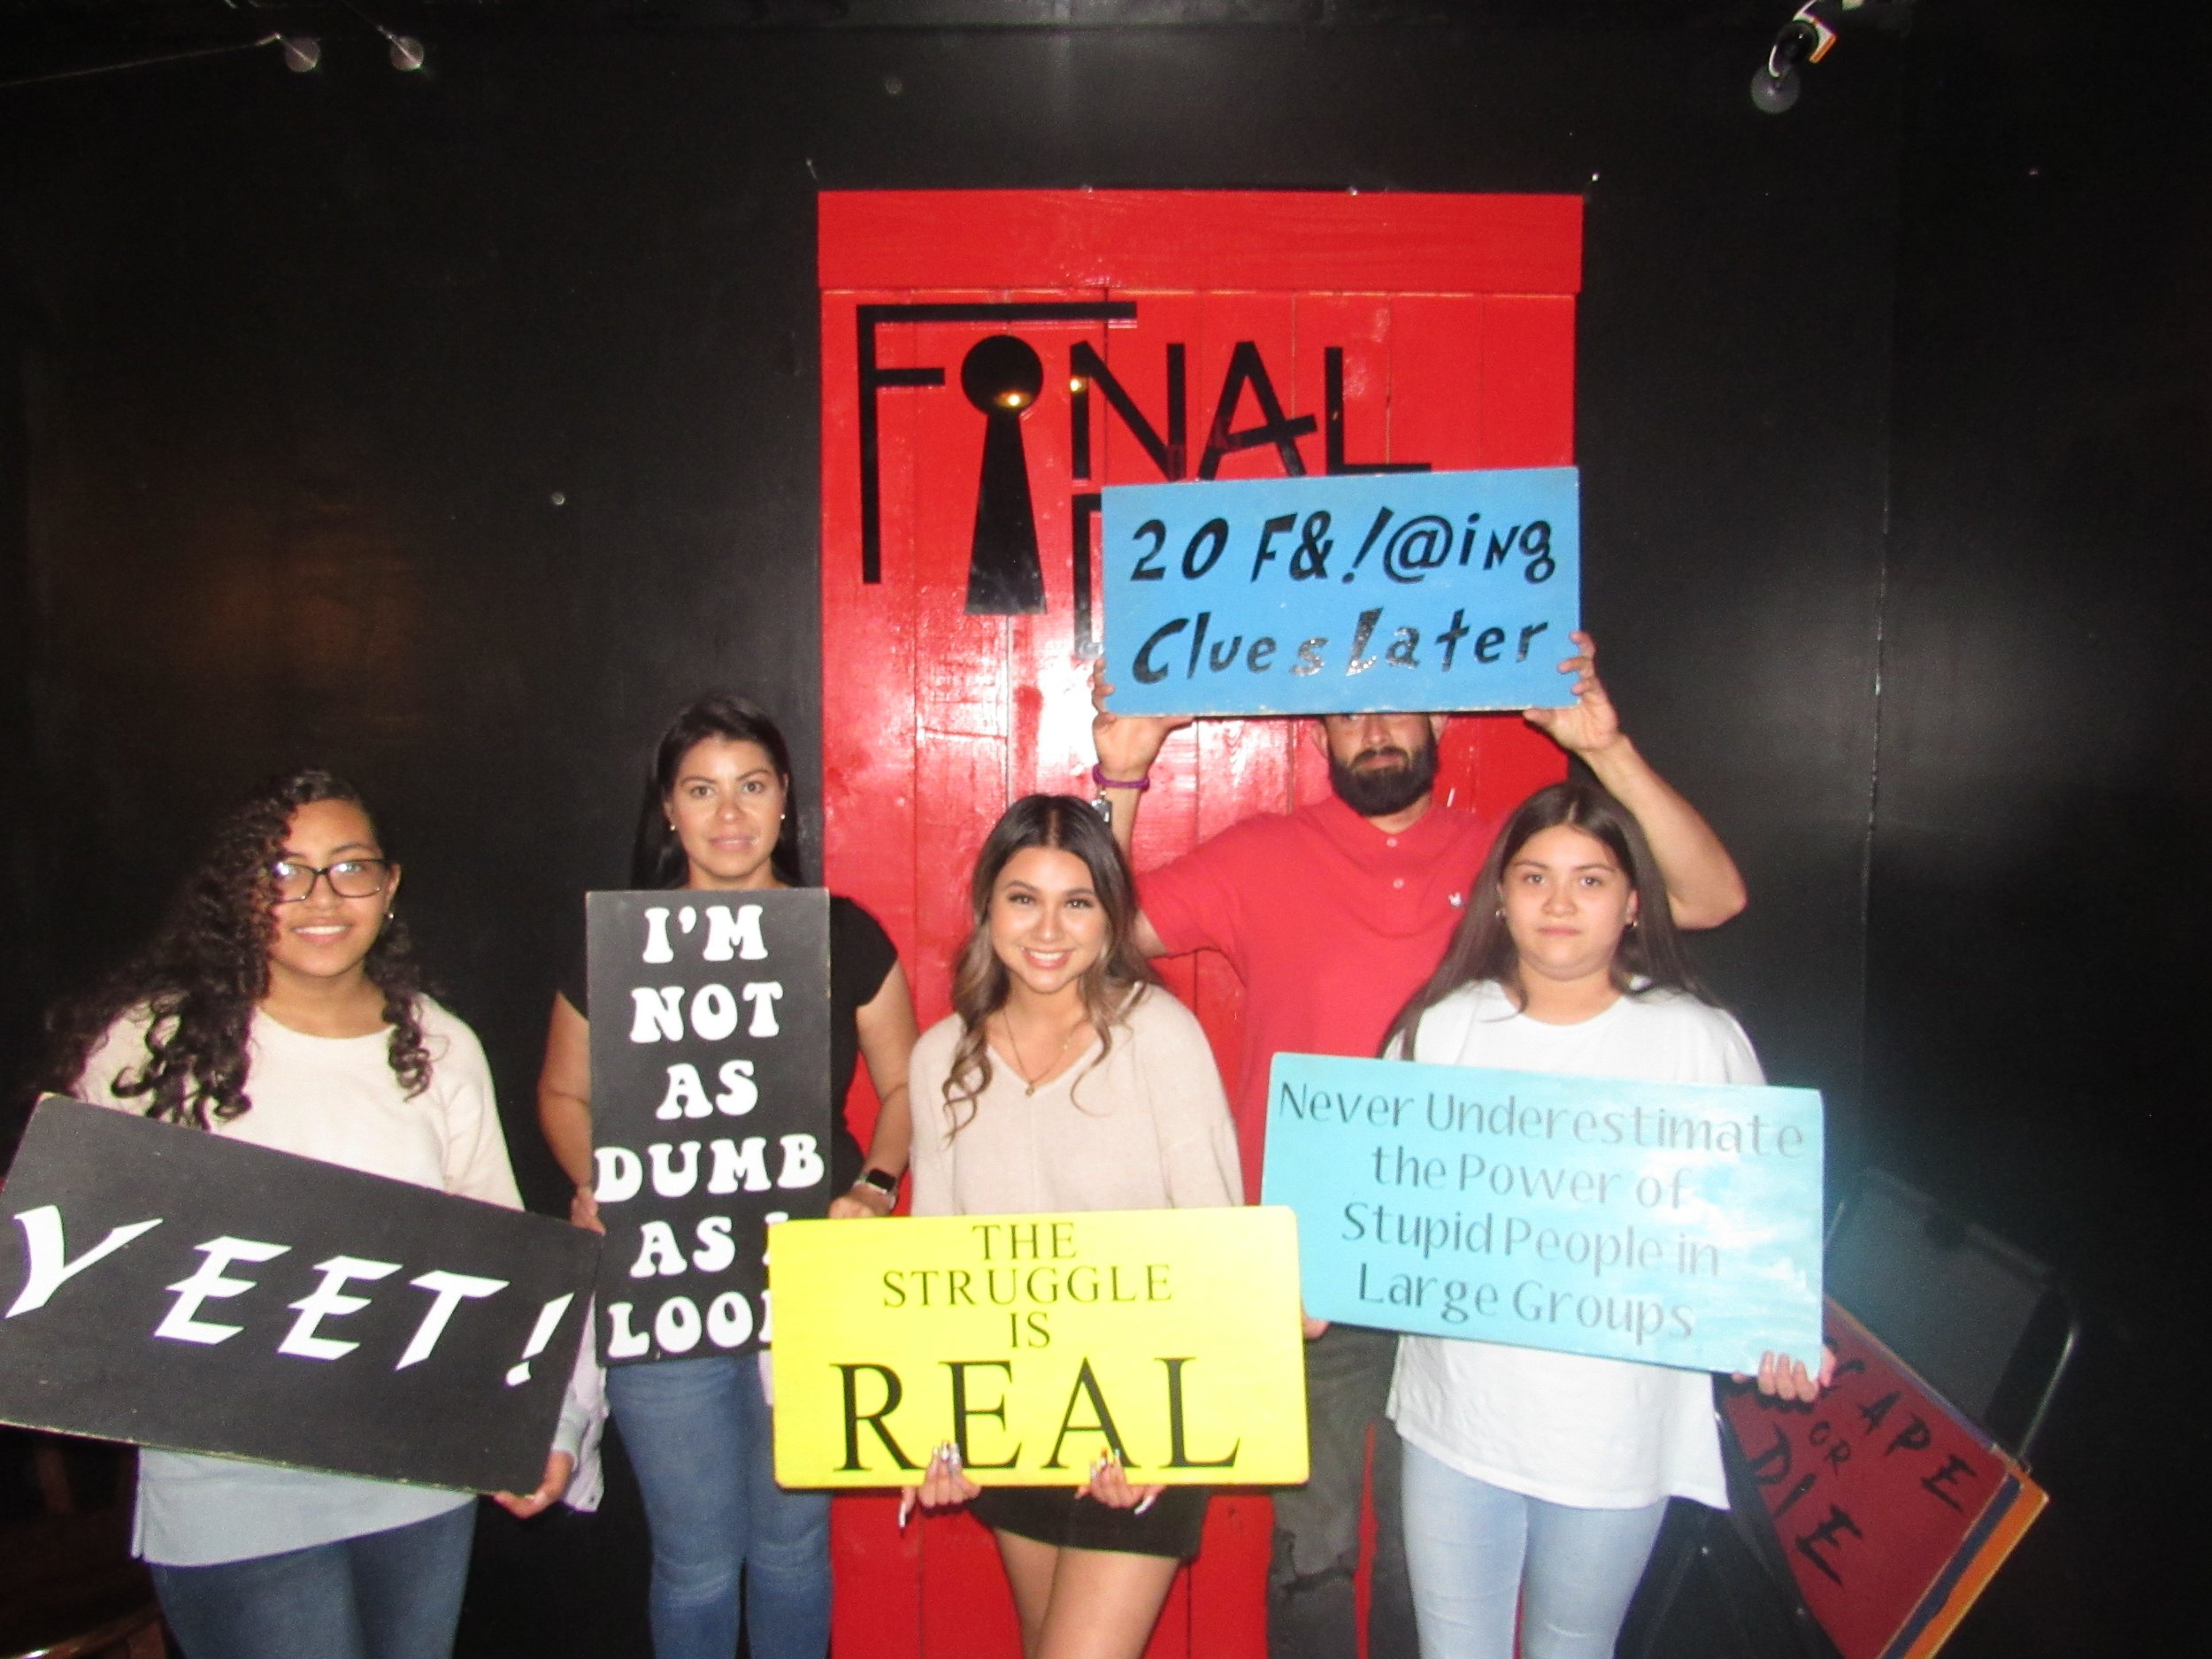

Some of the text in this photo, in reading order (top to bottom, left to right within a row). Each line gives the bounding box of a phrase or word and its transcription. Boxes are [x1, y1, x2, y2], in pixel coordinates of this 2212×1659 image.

[1131, 518, 1231, 582] 20
[1132, 607, 1548, 685] Clues Later
[642, 904, 768, 964] I'M
[629, 981, 783, 1043] NOT
[656, 1060, 759, 1119] AS
[1279, 1081, 1804, 1159] Never Underestimate
[593, 1133, 825, 1203] DUMB
[1372, 1146, 1691, 1210] the Power of
[629, 1217, 736, 1279] AS
[972, 1222, 1078, 1262] THE
[1341, 1202, 1720, 1277] Stupid People in
[4, 1204, 575, 1386] YEET!
[883, 1264, 1173, 1308] STRUGGLE
[1358, 1263, 1694, 1345] Large Groups
[1009, 1311, 1050, 1349] IS
[829, 1356, 1240, 1471] REAL
[1809, 1420, 1851, 1477] OR
[1745, 1425, 1863, 1587] DIE
